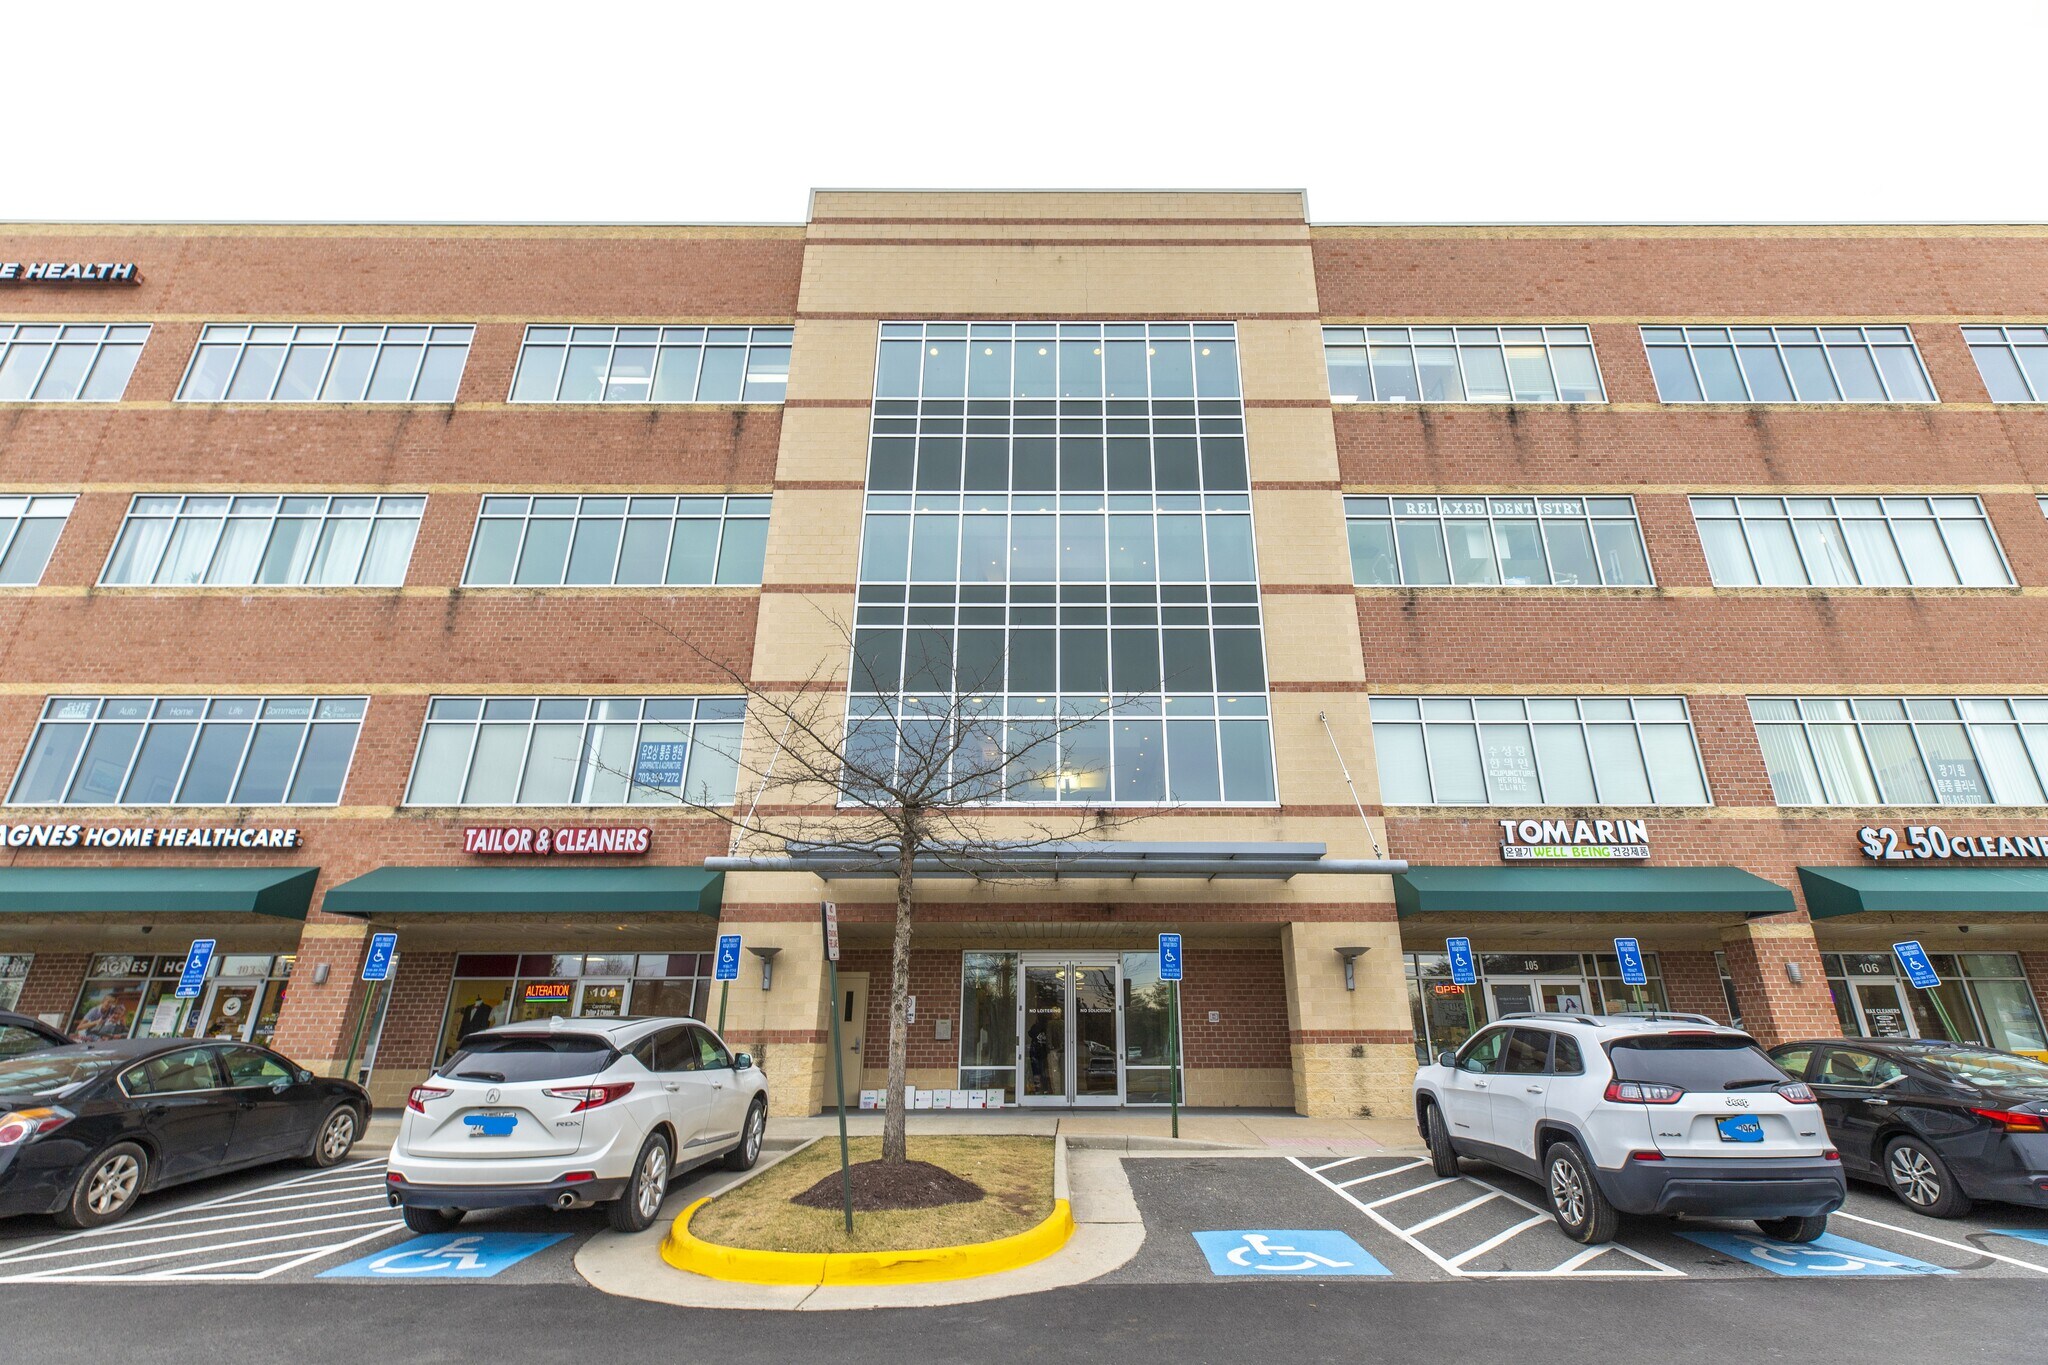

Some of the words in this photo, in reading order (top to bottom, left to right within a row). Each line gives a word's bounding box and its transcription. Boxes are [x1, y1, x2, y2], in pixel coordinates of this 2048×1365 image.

[0, 263, 19, 279] E
[25, 263, 134, 279] HEALTH
[1406, 502, 1486, 515] RELAXED
[1494, 502, 1582, 515] DENTISTRY
[119, 707, 137, 715] Auto
[170, 707, 194, 716] Home
[229, 706, 243, 715] Life
[659, 744, 671, 760] 통증
[672, 744, 684, 760] 병원
[1953, 779, 1977, 793] 클리닉
[85, 828, 153, 847] HOME
[157, 828, 297, 847] HEALTHCARE
[1500, 819, 1650, 844] TOMARIN
[465, 829, 532, 852] TAILOR
[536, 829, 550, 852] &
[554, 829, 649, 852] CLEANERS
[1859, 826, 1951, 860] $2.50
[1533, 846, 1568, 857] WELL
[1571, 846, 1611, 857] BEING
[1612, 846, 1649, 857] 건강제품
[98, 961, 148, 973] AGNES
[1524, 960, 1539, 971] 105
[1859, 963, 1880, 974] 106
[526, 985, 570, 997] ALTERATION
[1435, 985, 1465, 994] OPEN
[1725, 1097, 1750, 1109] Jeep
